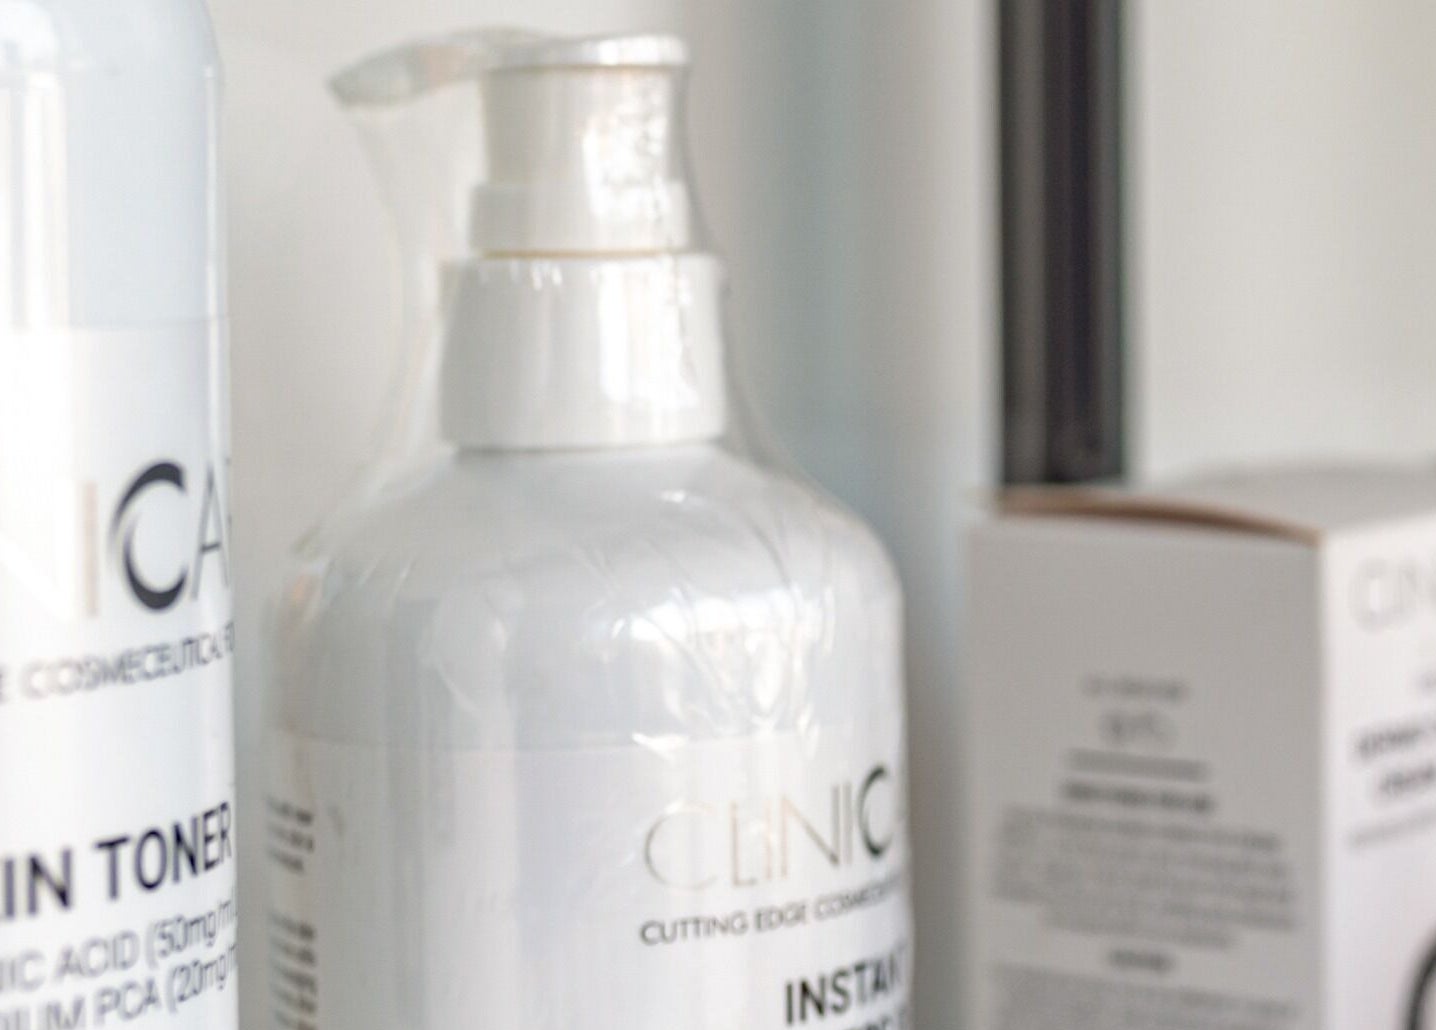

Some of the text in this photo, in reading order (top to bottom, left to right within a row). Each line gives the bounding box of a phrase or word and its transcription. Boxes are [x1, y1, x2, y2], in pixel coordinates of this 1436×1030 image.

[95, 801, 232, 900] TONER
[638, 910, 749, 948] CUTTING
[753, 898, 808, 934] EDGE
[55, 930, 141, 982] ACID
